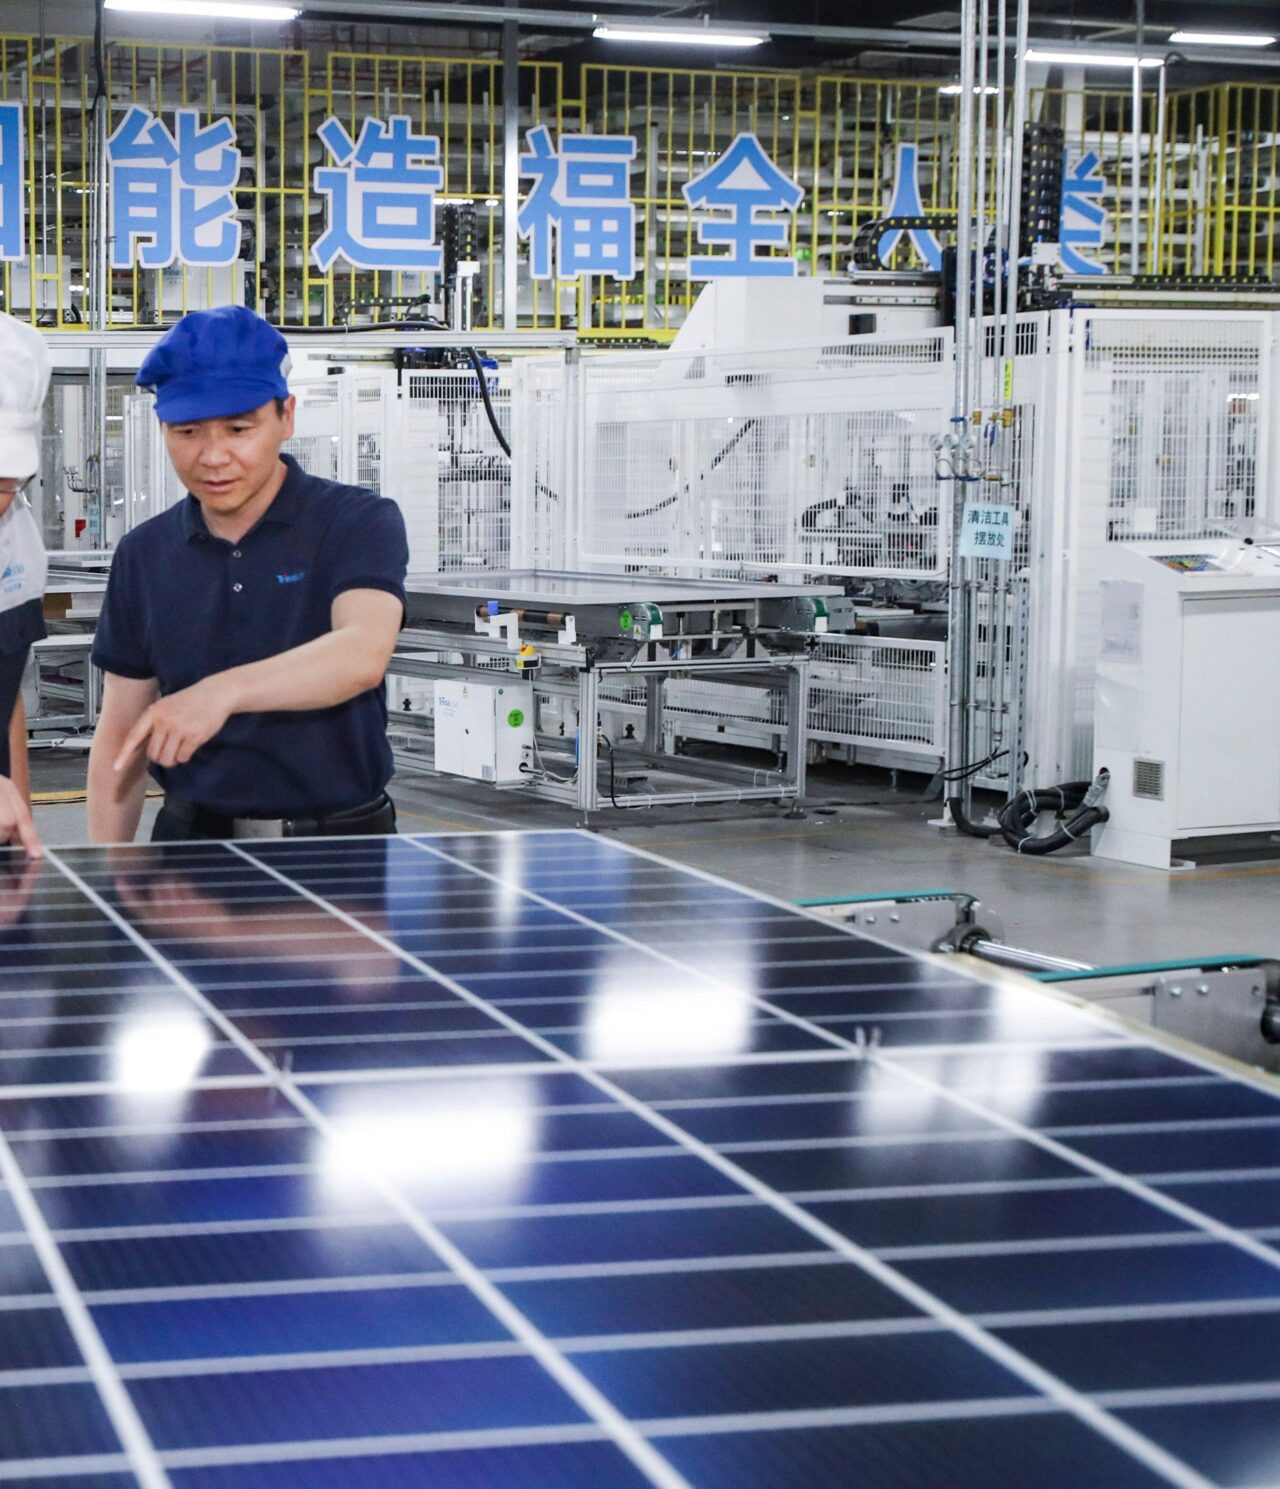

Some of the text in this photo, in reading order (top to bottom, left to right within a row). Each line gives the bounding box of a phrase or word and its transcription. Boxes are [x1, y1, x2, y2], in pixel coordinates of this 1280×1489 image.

[968, 510, 1008, 525] 清洁工具
[975, 531, 1004, 547] 摆放处
